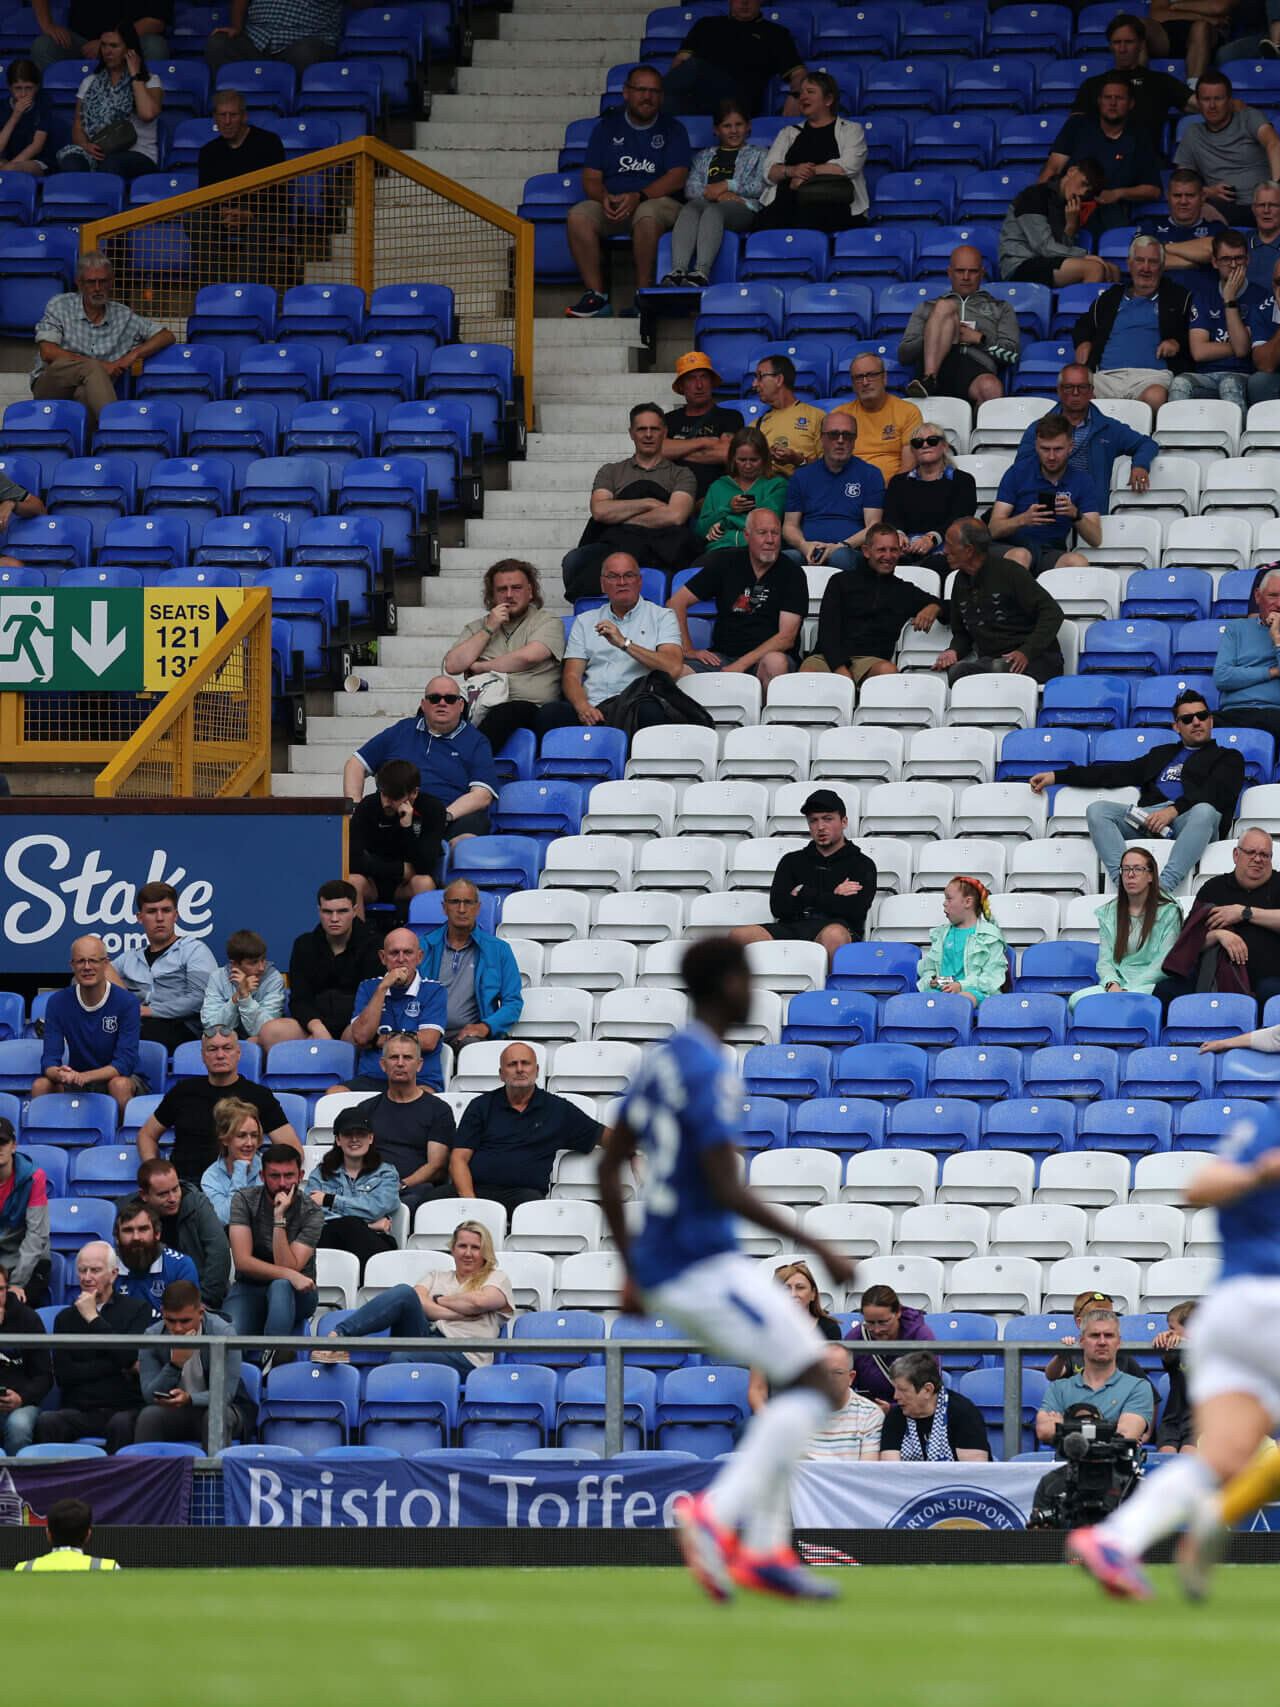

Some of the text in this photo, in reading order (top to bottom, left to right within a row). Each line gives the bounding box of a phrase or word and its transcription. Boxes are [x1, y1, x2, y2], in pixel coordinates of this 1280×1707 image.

[519, 425, 526, 446] V
[473, 482, 480, 500] U
[150, 604, 210, 620] SEATS
[389, 603, 396, 625] S
[156, 626, 199, 649] 121
[343, 653, 351, 676] R
[3, 834, 214, 945] Stake
[88, 932, 151, 955] om
[248, 1467, 460, 1527] Bristol
[903, 1497, 1015, 1529] RTON SUPPORT
